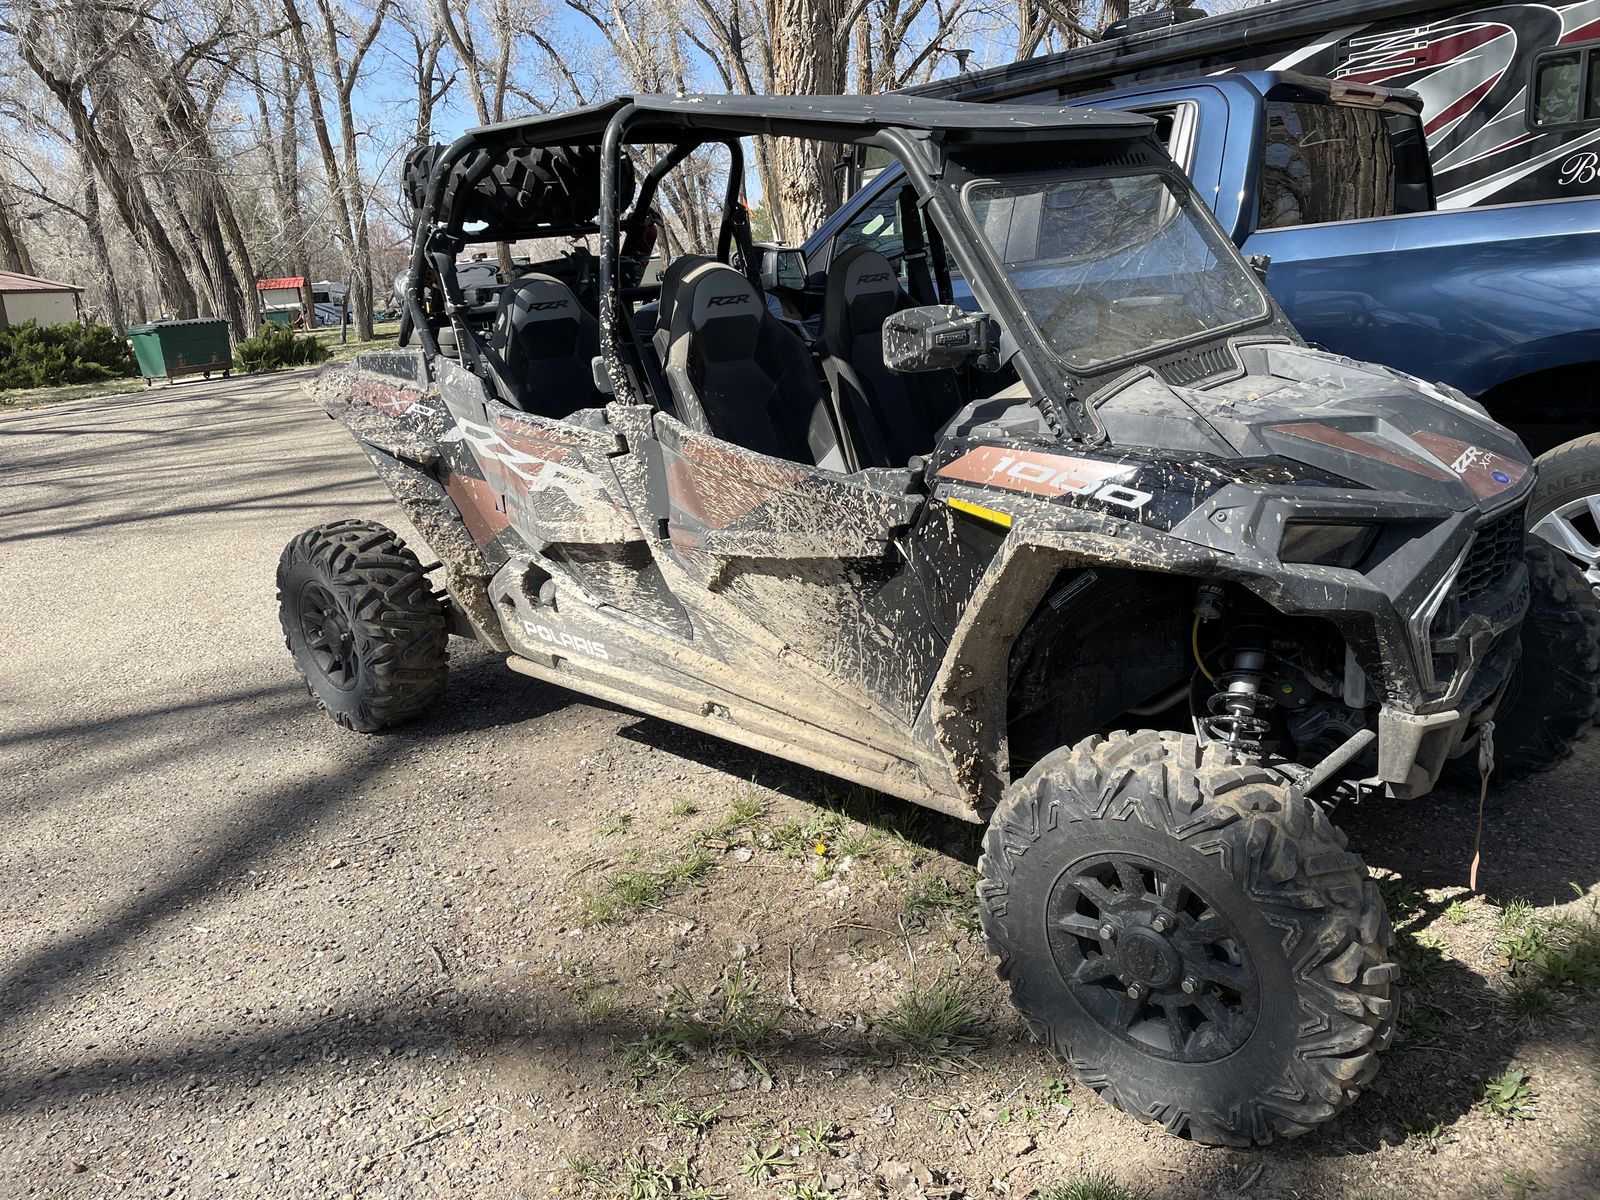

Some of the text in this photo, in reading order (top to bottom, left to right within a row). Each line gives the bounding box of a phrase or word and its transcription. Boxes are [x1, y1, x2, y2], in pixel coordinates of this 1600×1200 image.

[1558, 151, 1600, 185] B
[857, 272, 890, 286] RZR
[526, 300, 569, 313] RZR
[707, 294, 750, 308] RZR
[1450, 446, 1483, 474] RZR
[992, 455, 1153, 509] 1000
[523, 619, 609, 660] POLARIS
